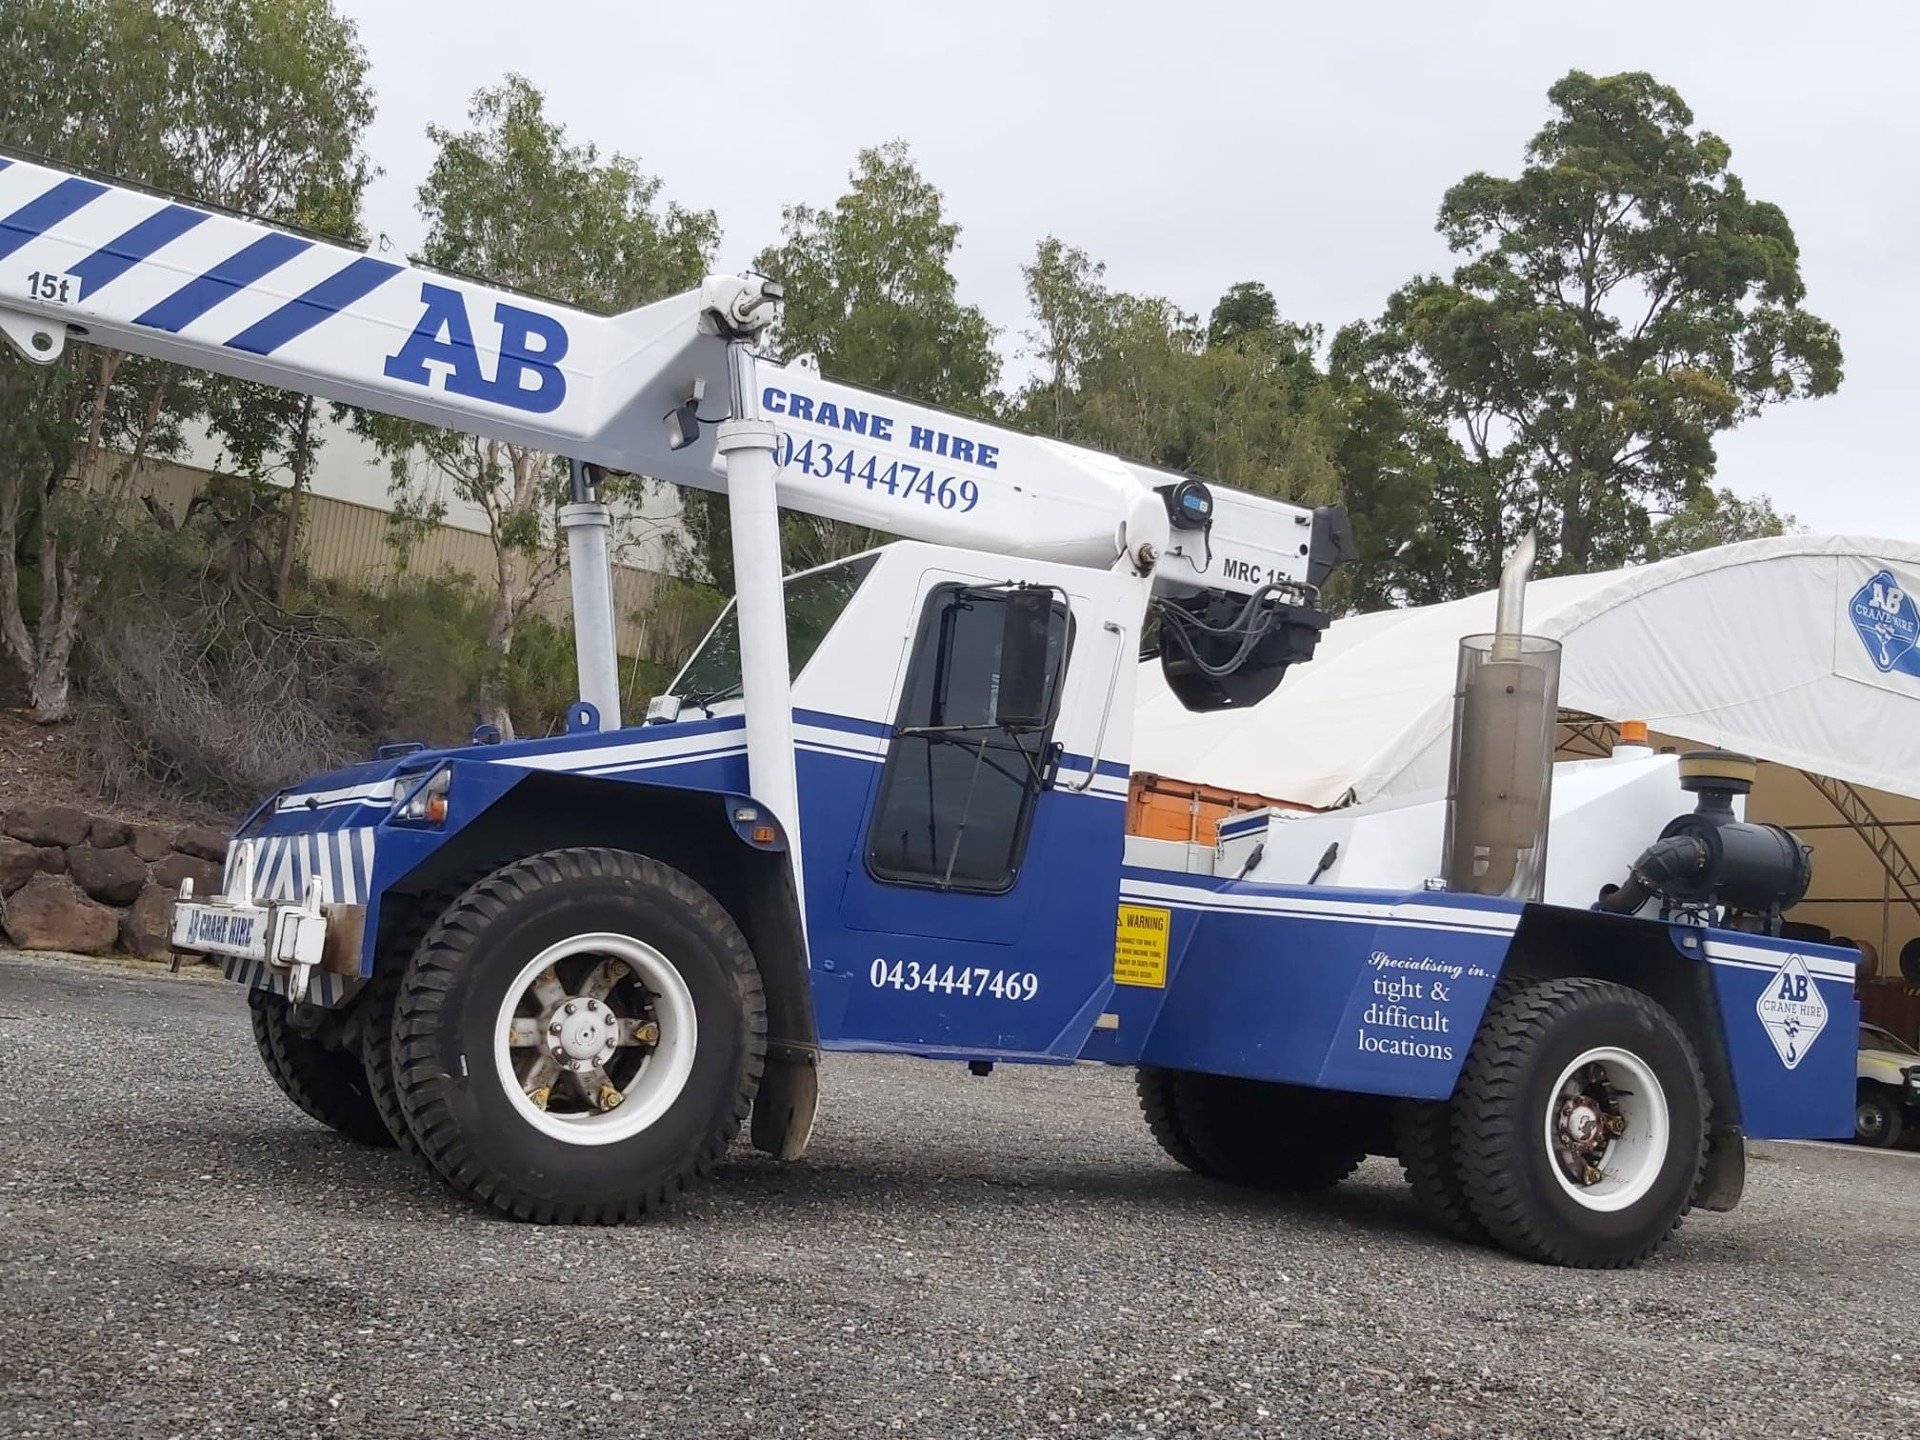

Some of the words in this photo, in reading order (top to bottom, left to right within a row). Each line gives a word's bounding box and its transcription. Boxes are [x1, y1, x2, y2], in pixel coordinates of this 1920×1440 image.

[28, 271, 69, 302] 15t
[384, 283, 569, 414] AB
[763, 387, 893, 441] CRANE
[909, 426, 999, 469] HIRE
[772, 432, 978, 512] 0434447469
[1223, 558, 1261, 584] MRC
[1855, 604, 1892, 623] CRANE
[1869, 583, 1904, 614] AB
[187, 909, 199, 944] AB
[199, 914, 229, 943] CRANE
[229, 917, 254, 947] HIRE
[1126, 914, 1164, 931] WARNING
[870, 958, 1038, 1001] 0434447469
[1368, 951, 1463, 979] Specialising
[1373, 975, 1423, 1002] tight
[1431, 982, 1450, 1001] &
[1778, 973, 1808, 1002] AB
[1364, 1003, 1449, 1033] difficult
[1763, 1000, 1797, 1014] CRANE
[1800, 1004, 1822, 1017] HIRE
[1358, 1029, 1453, 1060] locations
